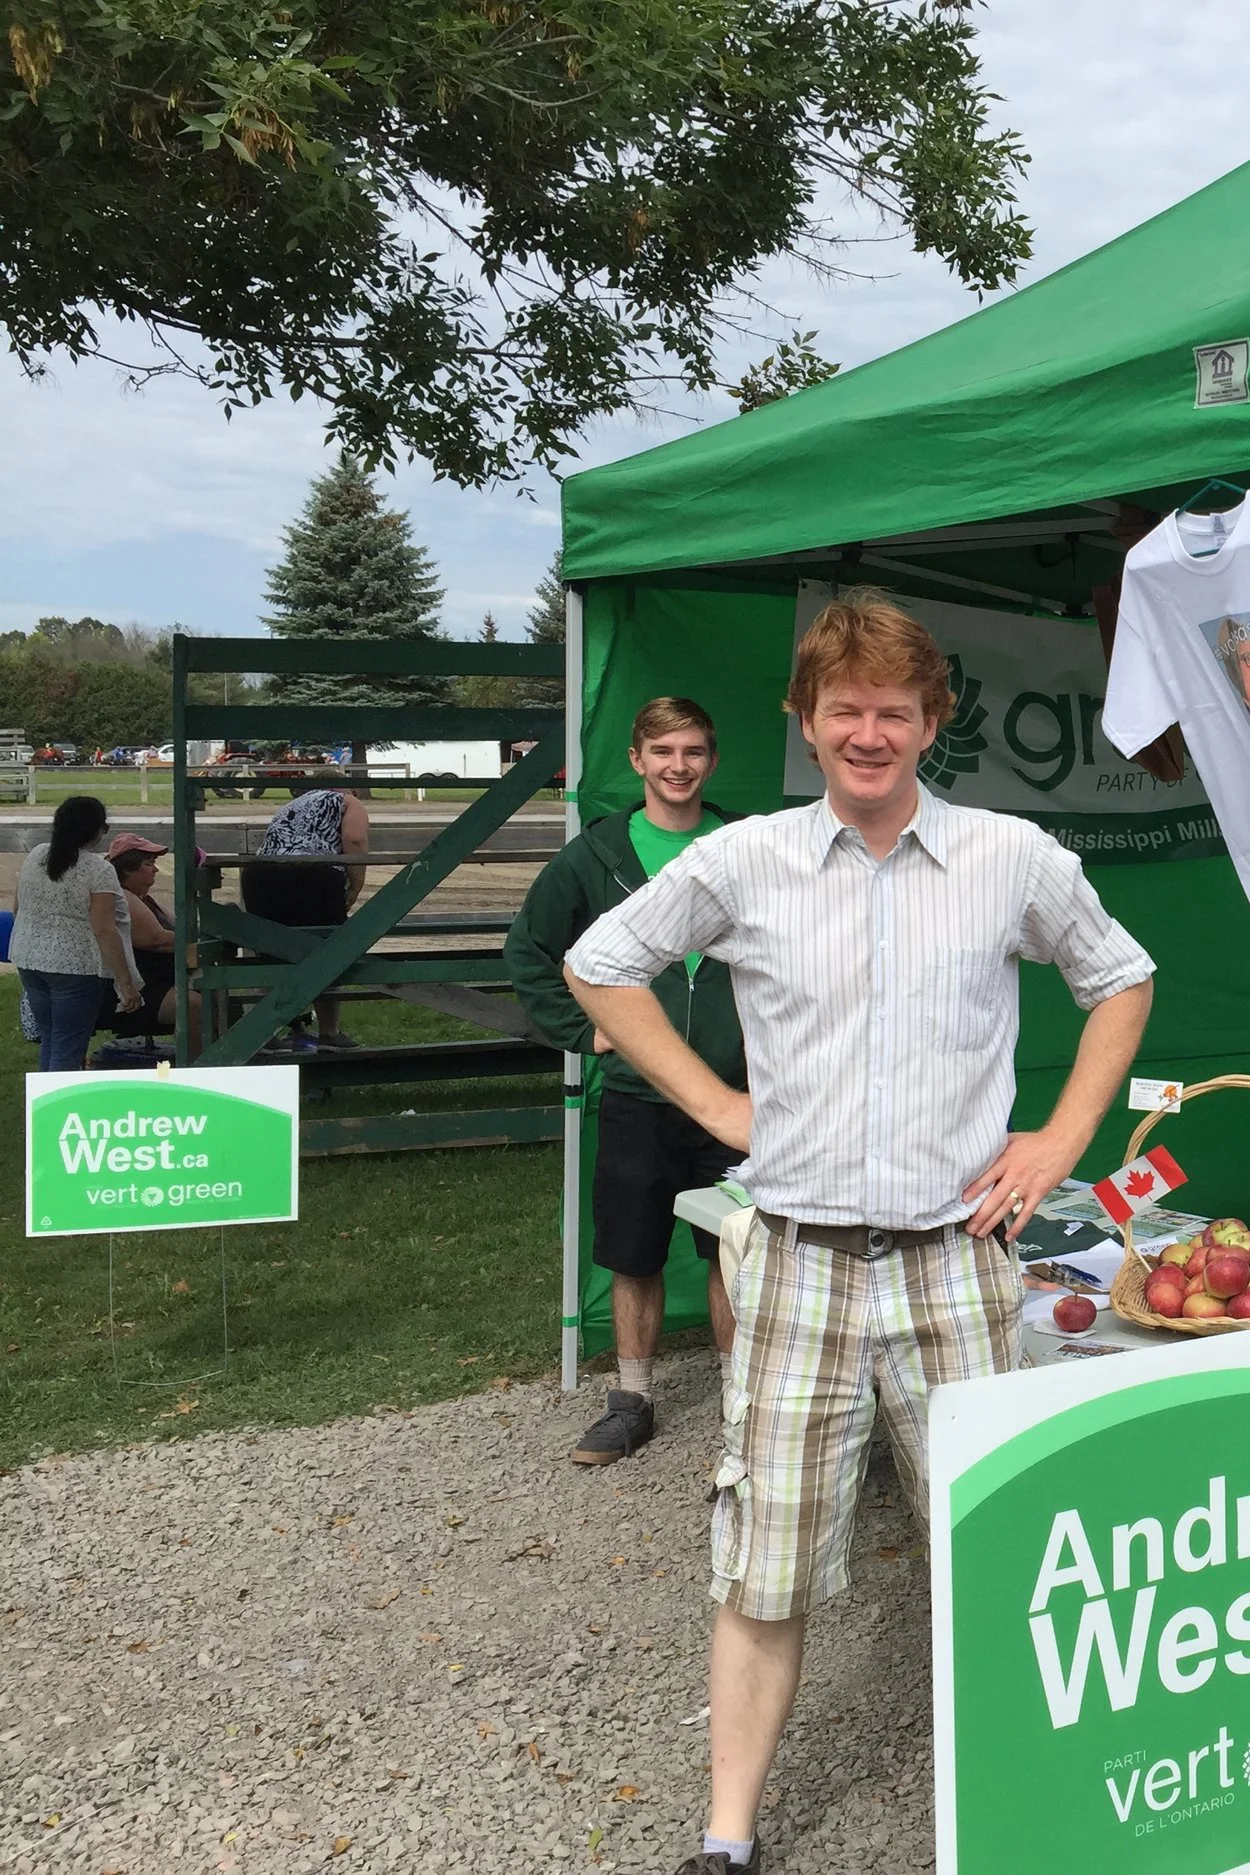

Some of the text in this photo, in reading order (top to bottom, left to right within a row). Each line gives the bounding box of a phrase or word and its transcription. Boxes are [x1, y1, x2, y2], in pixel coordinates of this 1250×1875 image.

[1177, 818, 1223, 841] Mill
[58, 1111, 208, 1140] Andrew
[58, 1139, 209, 1174] West.ca
[86, 1181, 242, 1206] vert green
[1103, 1750, 1147, 1773] PARTI
[1105, 1726, 1235, 1823] vert
[1135, 1793, 1235, 1837] DE L'ONTARIO
